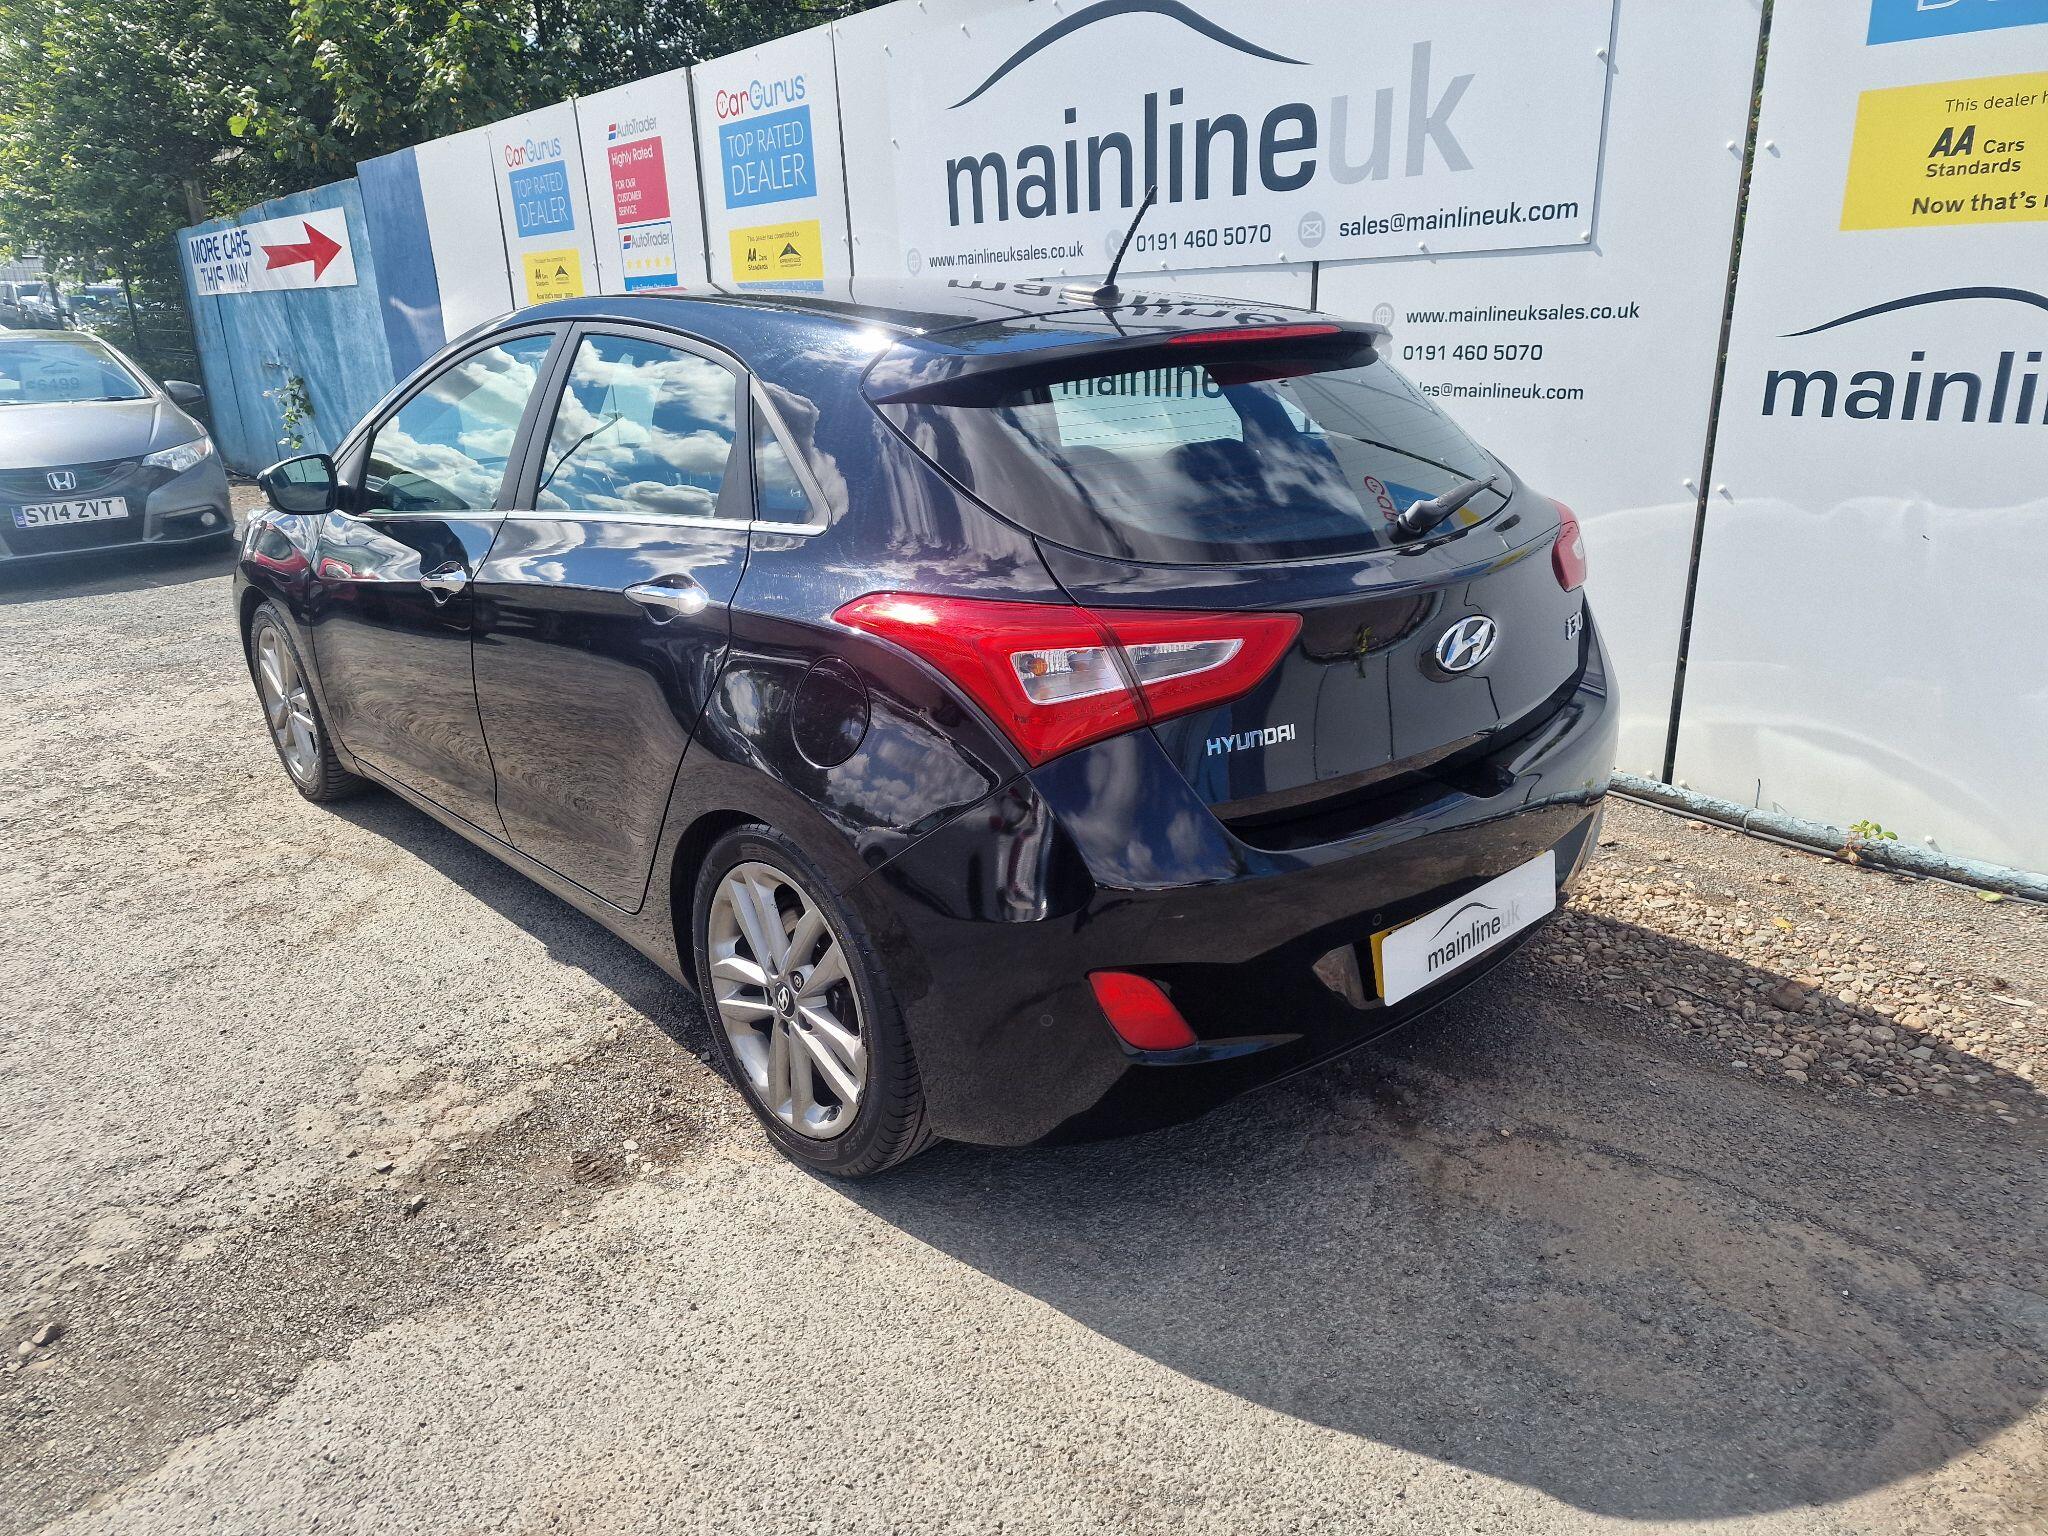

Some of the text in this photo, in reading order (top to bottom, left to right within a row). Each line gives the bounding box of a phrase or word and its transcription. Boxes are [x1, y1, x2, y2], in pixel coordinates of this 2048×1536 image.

[716, 75, 806, 118] CarGurus
[1945, 98, 1978, 114] This
[1983, 92, 2038, 110] dealer
[616, 116, 657, 138] AutoTrader
[727, 121, 804, 157] TOP RATED
[946, 40, 1476, 227] mainlineuk
[505, 137, 561, 167] CarGurus
[1928, 125, 2025, 158] AA Cars
[611, 145, 653, 167] Highly Rated
[1925, 158, 2022, 178] Standards
[514, 171, 564, 198] TOP RATED
[731, 153, 808, 196] DEALER
[519, 196, 569, 228] DEALER
[618, 204, 638, 216] SERVICE
[1912, 197, 1965, 215] Now
[1971, 191, 2037, 212] that's
[1339, 201, 1579, 237] sales@mainlineuk.com
[191, 230, 251, 264] MORE CARS
[632, 231, 670, 248] AutoTrader
[1136, 223, 1272, 252] 0191 460 5070
[929, 241, 1084, 268] www.mainlineuksales.co.uk
[200, 265, 225, 291] THIS
[1406, 302, 1640, 323] www.mainlineuksales.co.uk
[1403, 344, 1543, 360] 0191 460 5070
[1419, 382, 1584, 400] es@mainlineuk.com
[1761, 350, 2048, 425] mainli
[25, 504, 70, 524] SY14
[75, 500, 112, 518] ZVT
[1206, 723, 1296, 756] HYUNDAI
[1427, 901, 1521, 973] mainlineuk
